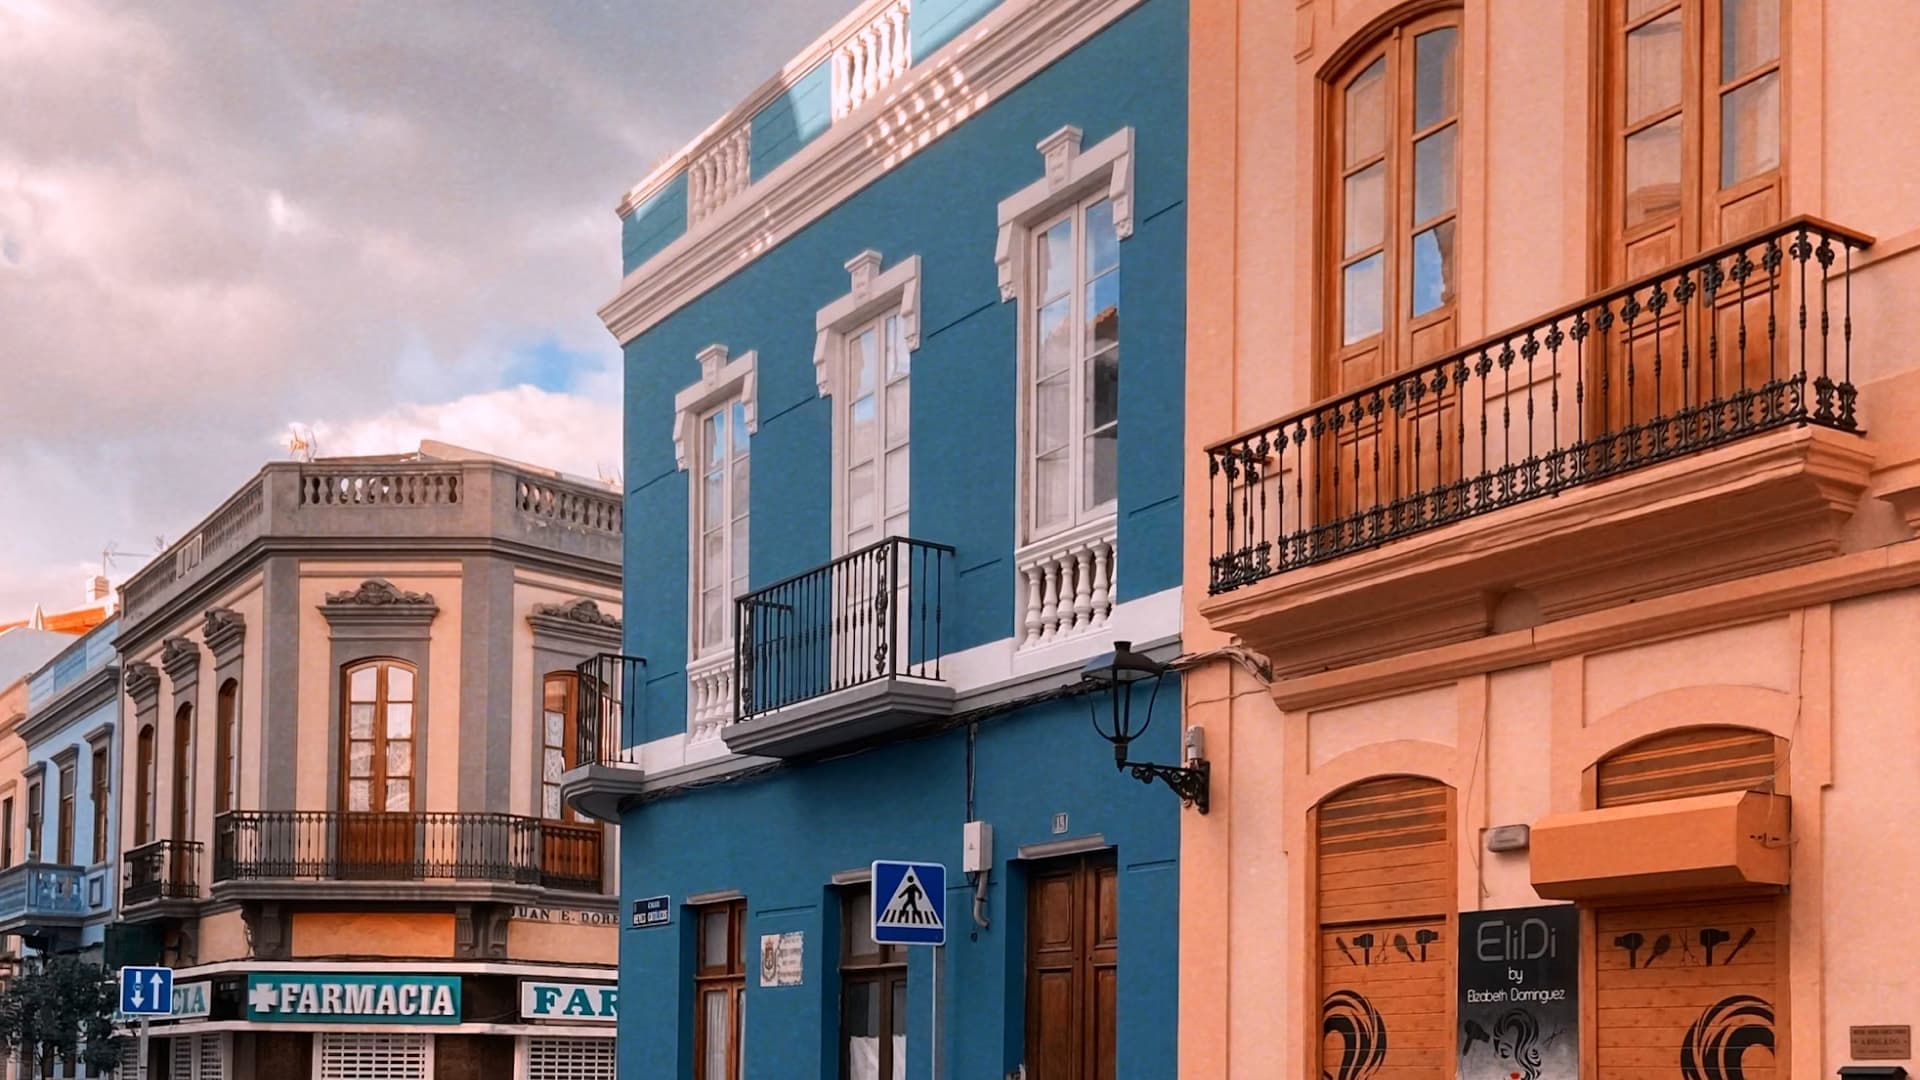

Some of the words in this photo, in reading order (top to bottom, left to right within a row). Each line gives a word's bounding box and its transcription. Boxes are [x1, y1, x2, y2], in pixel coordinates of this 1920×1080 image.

[511, 905, 550, 920] JUAN
[561, 910, 575, 921] E.
[1477, 918, 1556, 960] EliDi
[1508, 966, 1523, 984] by
[279, 983, 455, 1016] FARMACIA
[533, 986, 618, 1017] FAR
[1467, 988, 1508, 1003] Elizabeth
